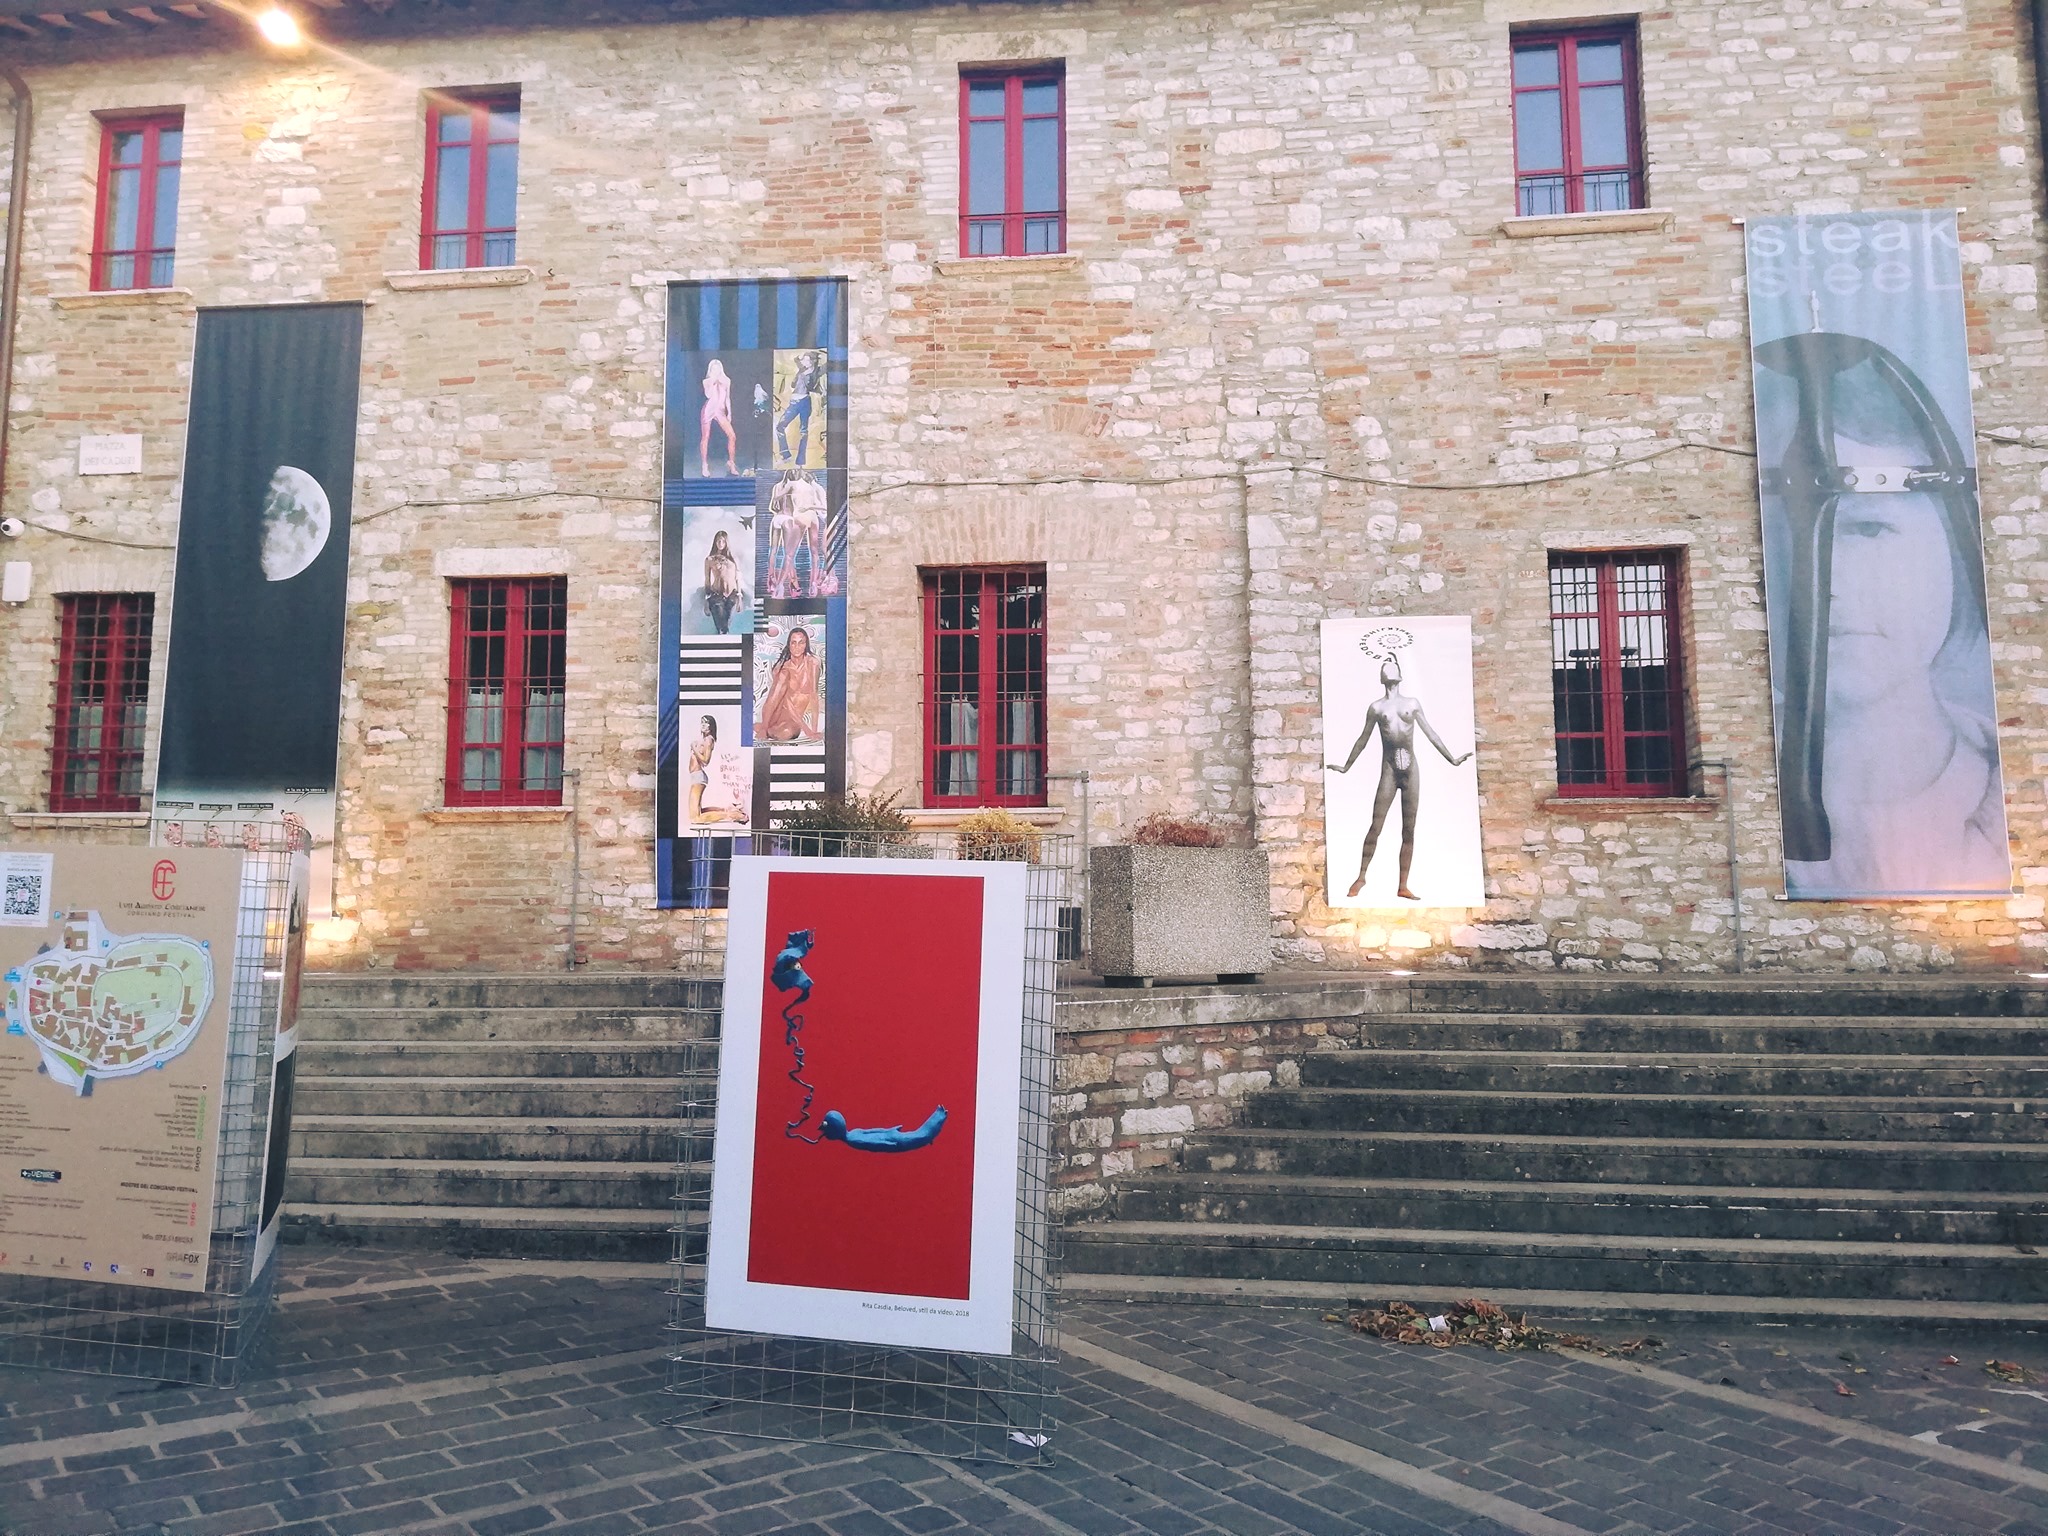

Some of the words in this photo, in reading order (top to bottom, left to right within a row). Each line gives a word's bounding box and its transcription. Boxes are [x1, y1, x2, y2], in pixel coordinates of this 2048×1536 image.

[1750, 209, 1959, 257] steak
[95, 442, 127, 450] PIAZZA
[84, 456, 99, 466] DEI
[101, 455, 136, 466] CADUTI
[163, 911, 196, 919] FESTIVAL
[873, 1303, 893, 1311] Casdia,
[894, 1305, 918, 1314] Beloved,
[937, 1308, 955, 1317] video,
